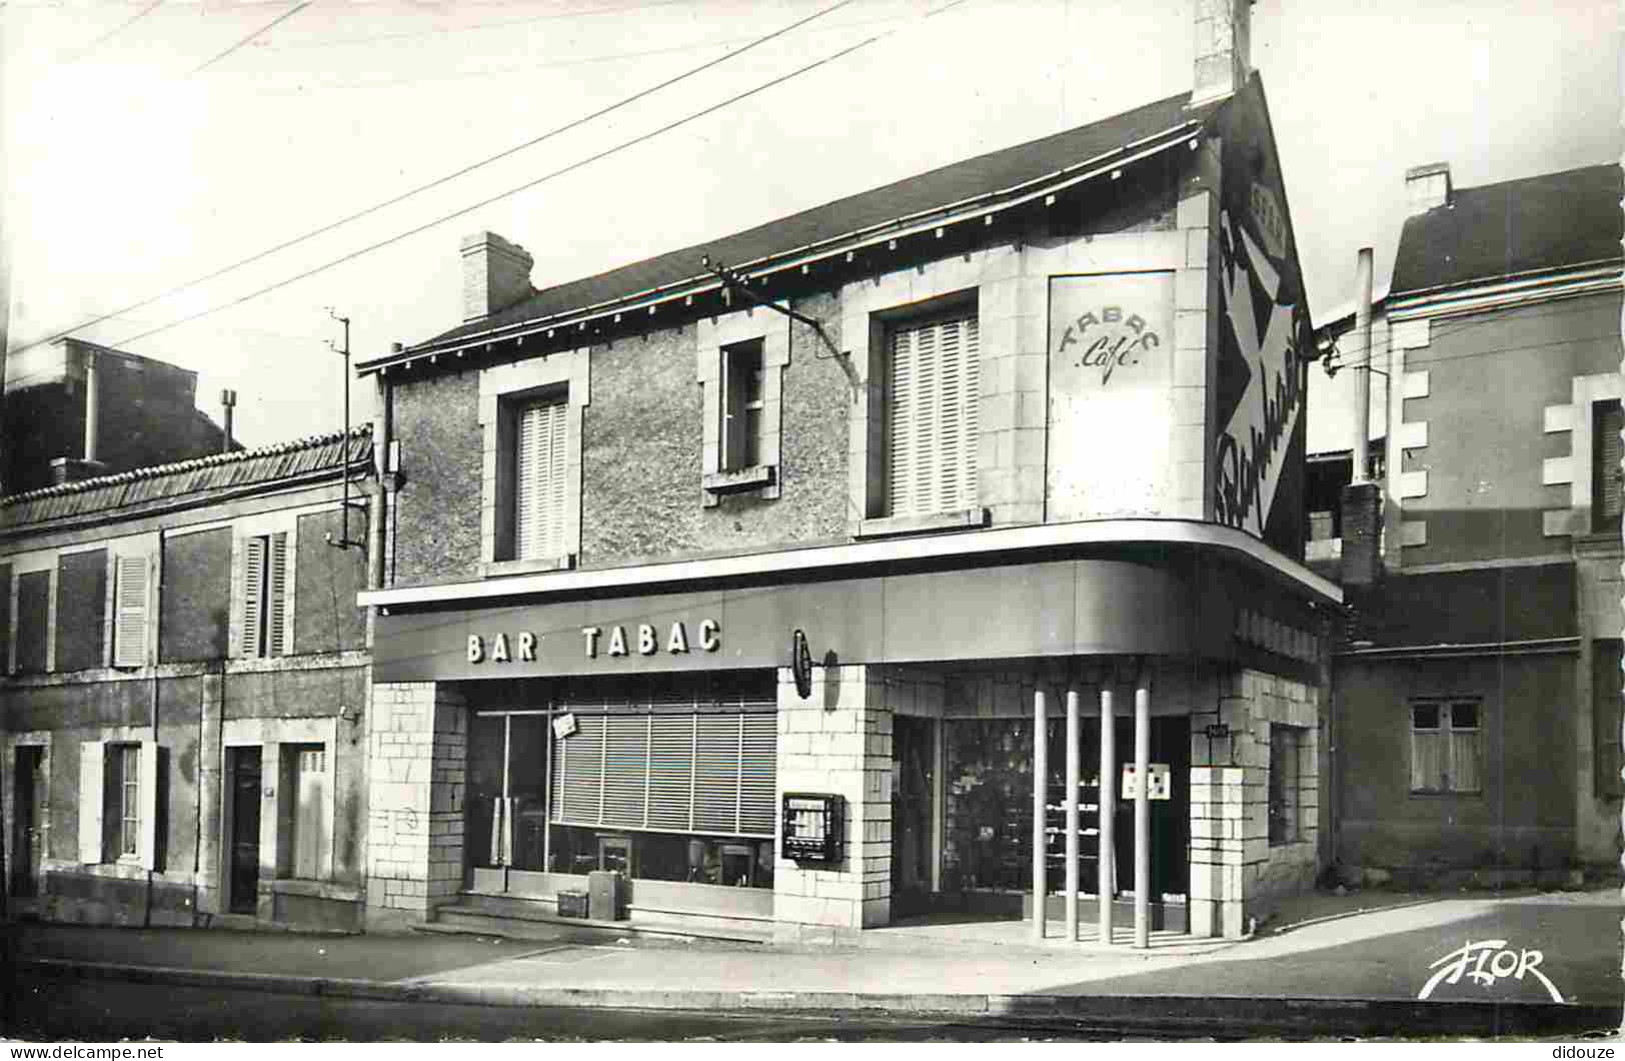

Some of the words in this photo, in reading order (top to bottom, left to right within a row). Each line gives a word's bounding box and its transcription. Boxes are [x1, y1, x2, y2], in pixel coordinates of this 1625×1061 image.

[1058, 305, 1160, 353] TABAC
[466, 631, 537, 664] BAR
[581, 618, 721, 659] TABAC
